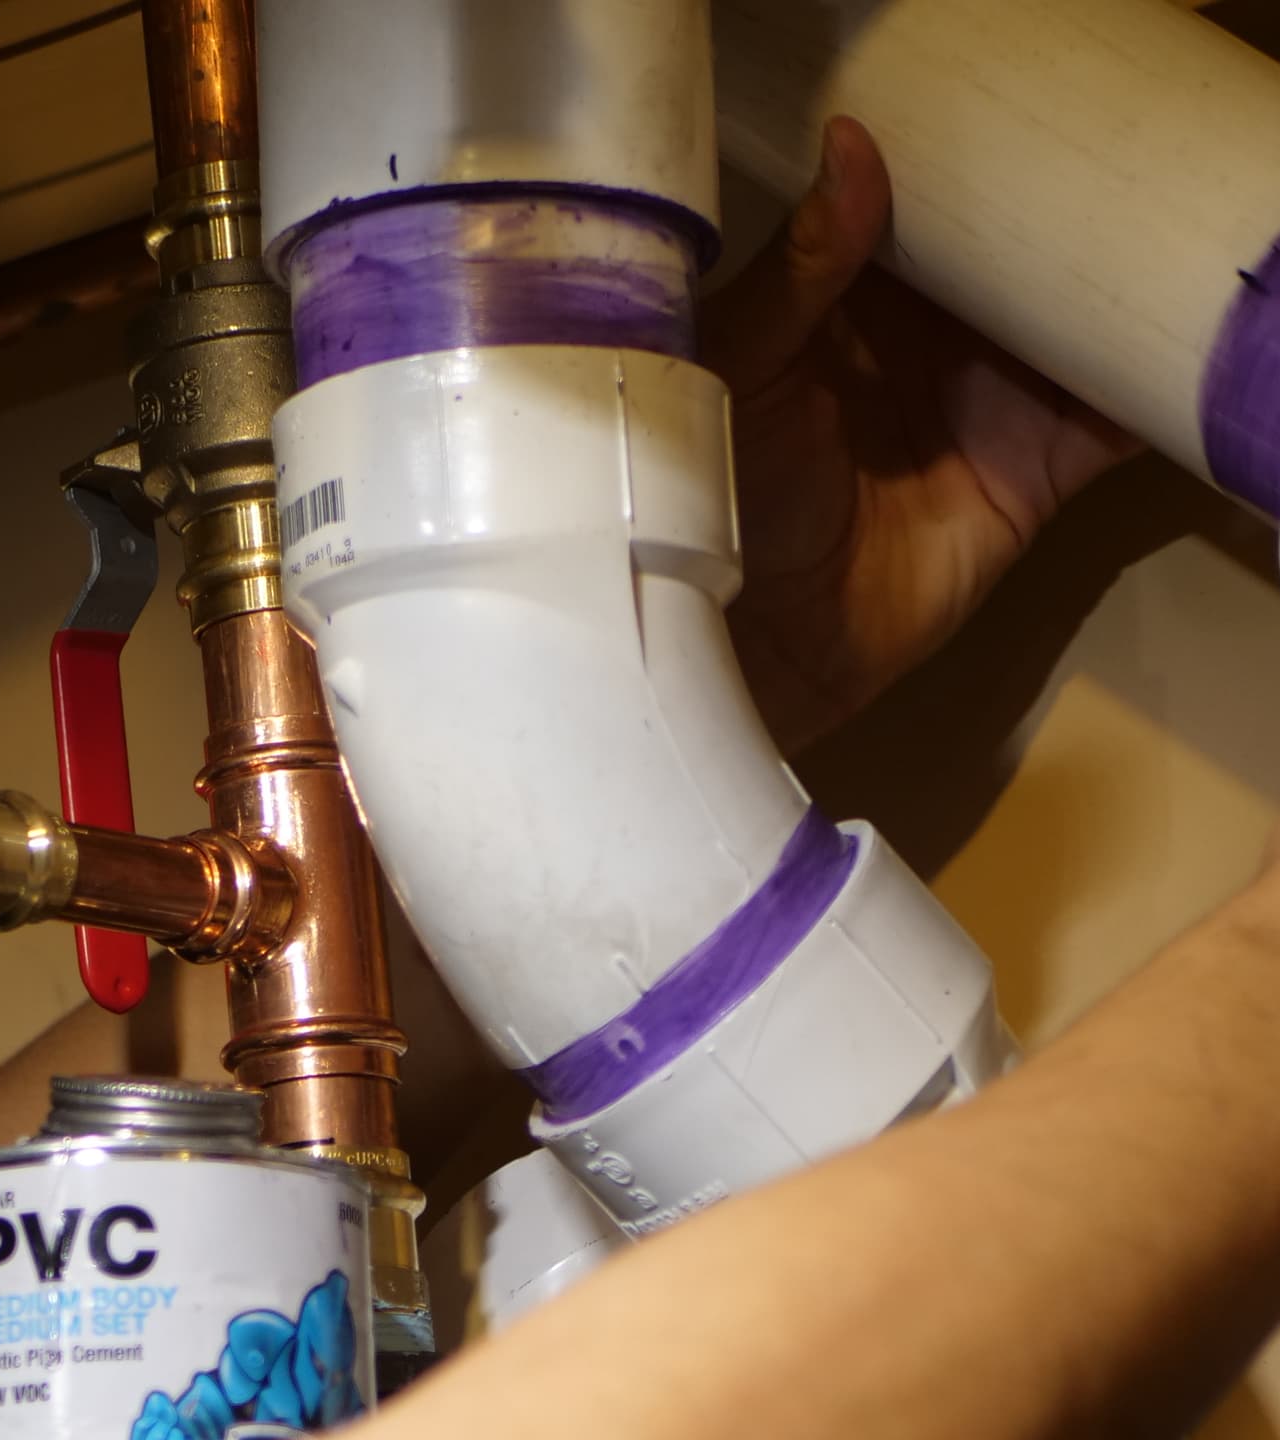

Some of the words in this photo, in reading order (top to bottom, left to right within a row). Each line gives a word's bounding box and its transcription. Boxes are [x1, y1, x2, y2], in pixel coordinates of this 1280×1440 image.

[90, 1285, 178, 1310] BODY
[91, 1312, 149, 1336] SET
[72, 1344, 144, 1363] Cement
[13, 1382, 51, 1405] VOC
